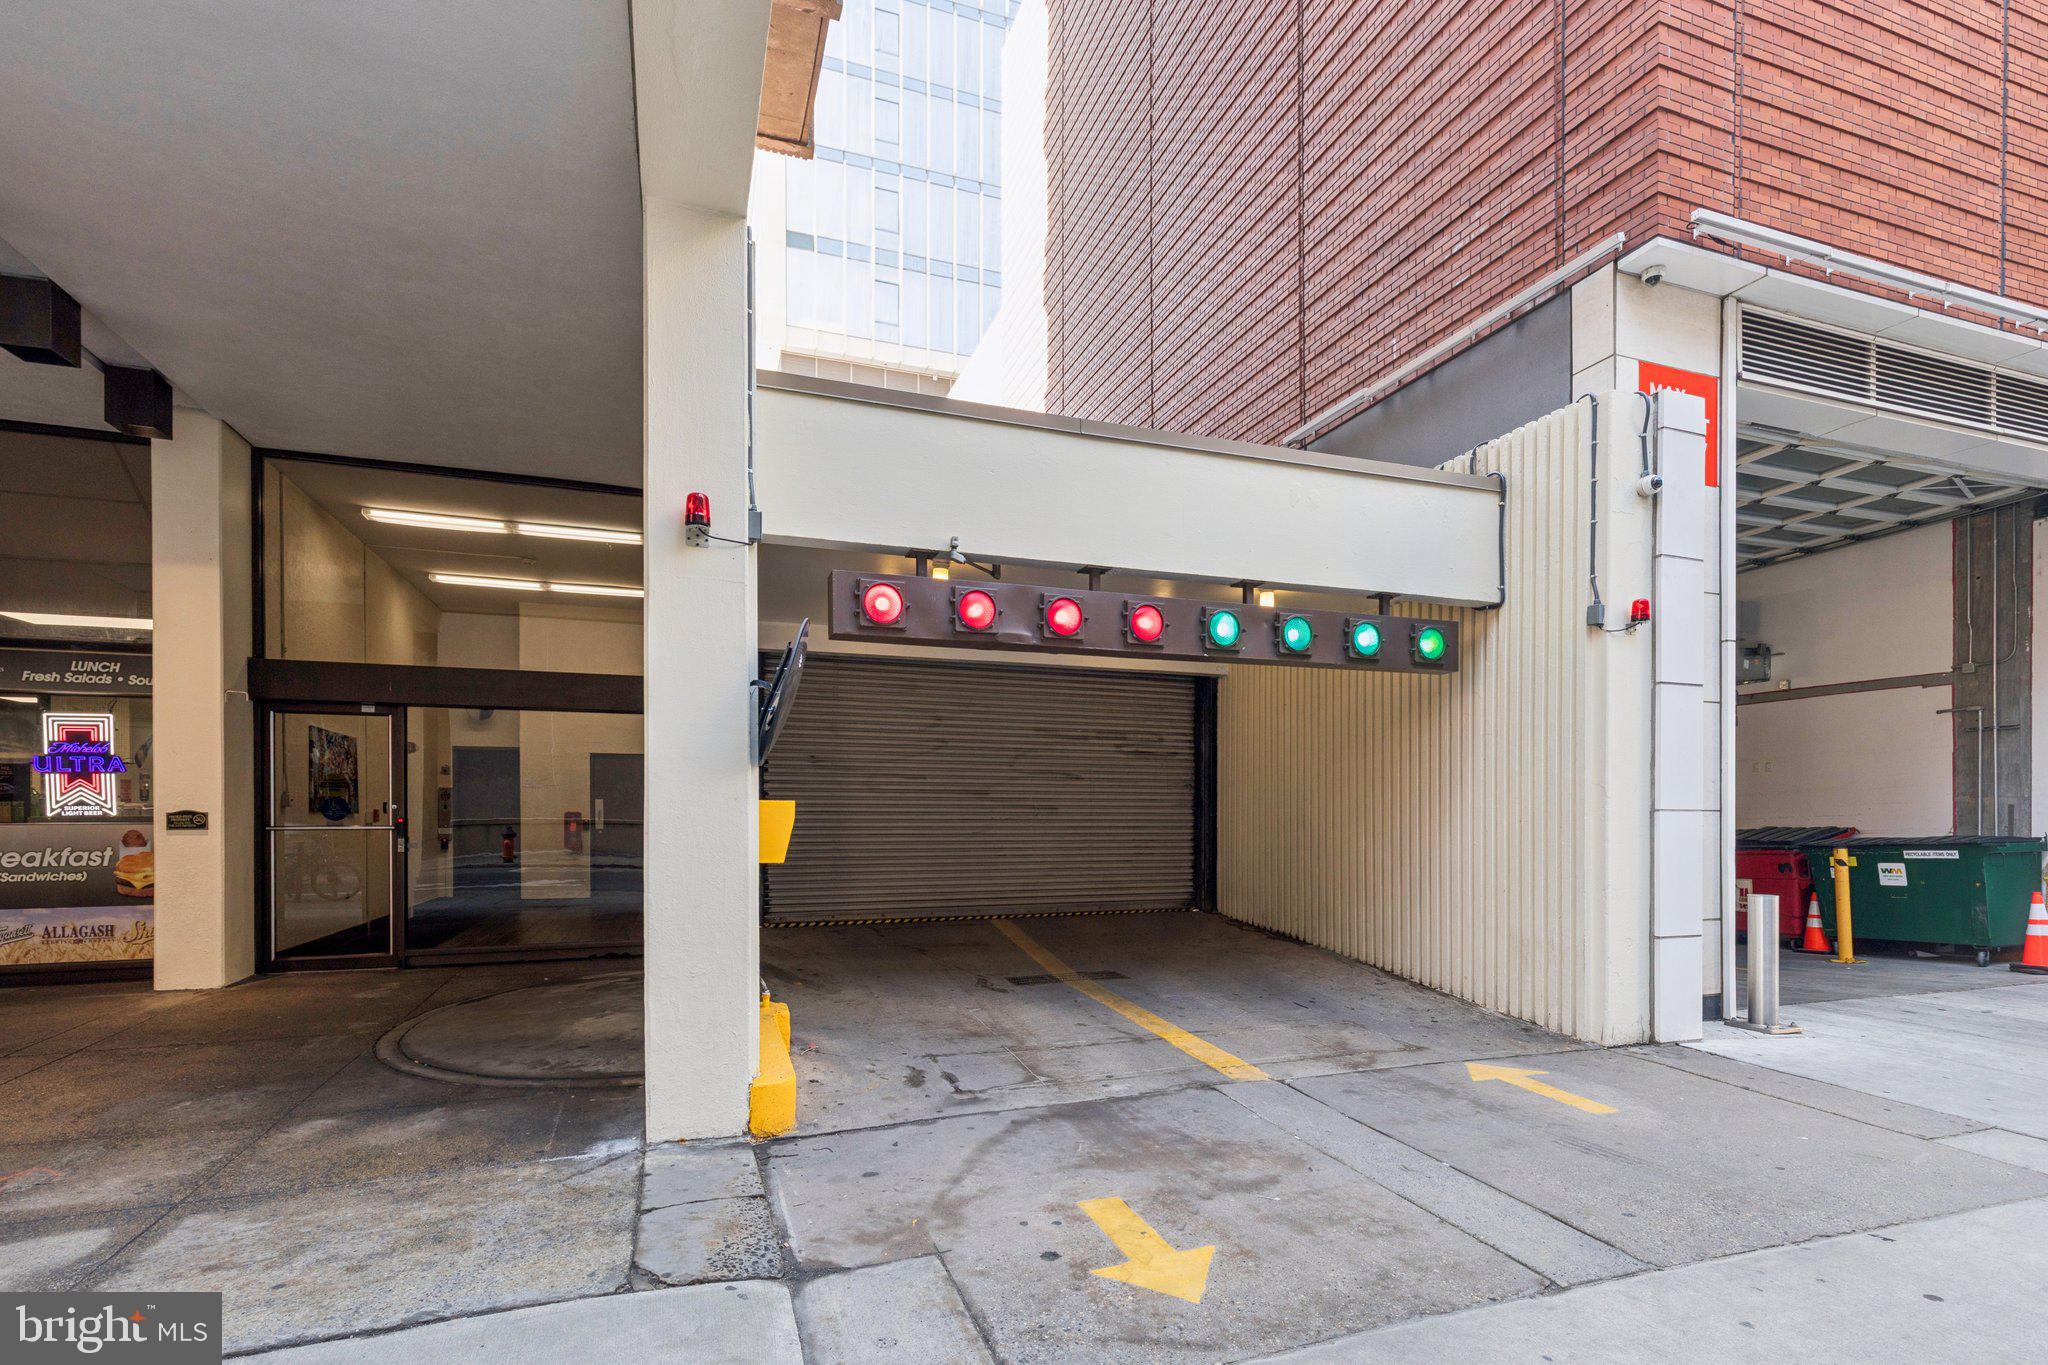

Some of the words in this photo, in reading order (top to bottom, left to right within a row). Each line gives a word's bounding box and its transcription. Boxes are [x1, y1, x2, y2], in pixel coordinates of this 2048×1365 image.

[71, 660, 121, 673] LUNCH
[22, 670, 60, 683] Fresh
[63, 672, 112, 684] Salads
[48, 741, 110, 754] Michelob
[33, 755, 126, 772] ULTRA
[0, 846, 114, 868] eakfast
[42, 924, 116, 939] ALLAGASH
